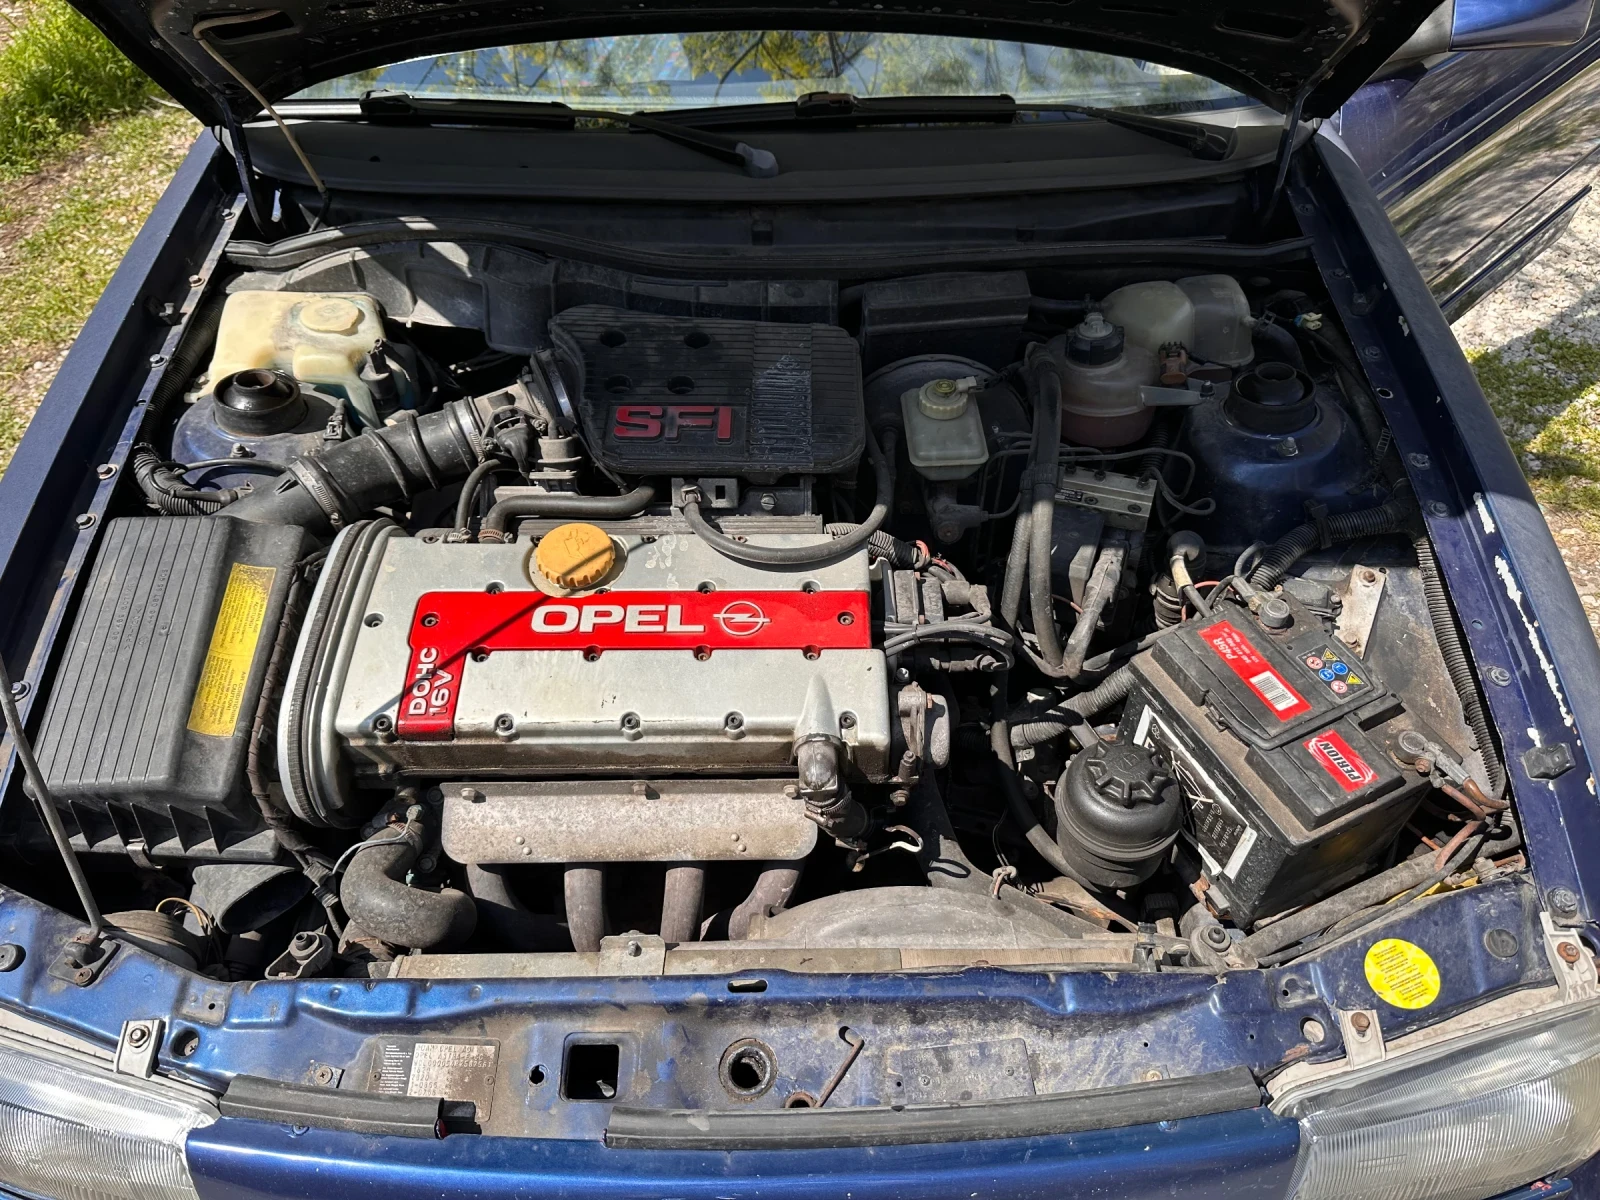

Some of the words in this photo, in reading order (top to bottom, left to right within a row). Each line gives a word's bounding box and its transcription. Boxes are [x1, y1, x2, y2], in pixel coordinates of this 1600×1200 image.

[613, 406, 732, 440] SFI
[530, 604, 705, 633] OPEL
[1213, 637, 1238, 660] P45R
[225, 683, 237, 711] CAUTION!
[408, 647, 438, 715] DOHC
[429, 669, 454, 716] 16V
[1320, 742, 1361, 780] PERION
